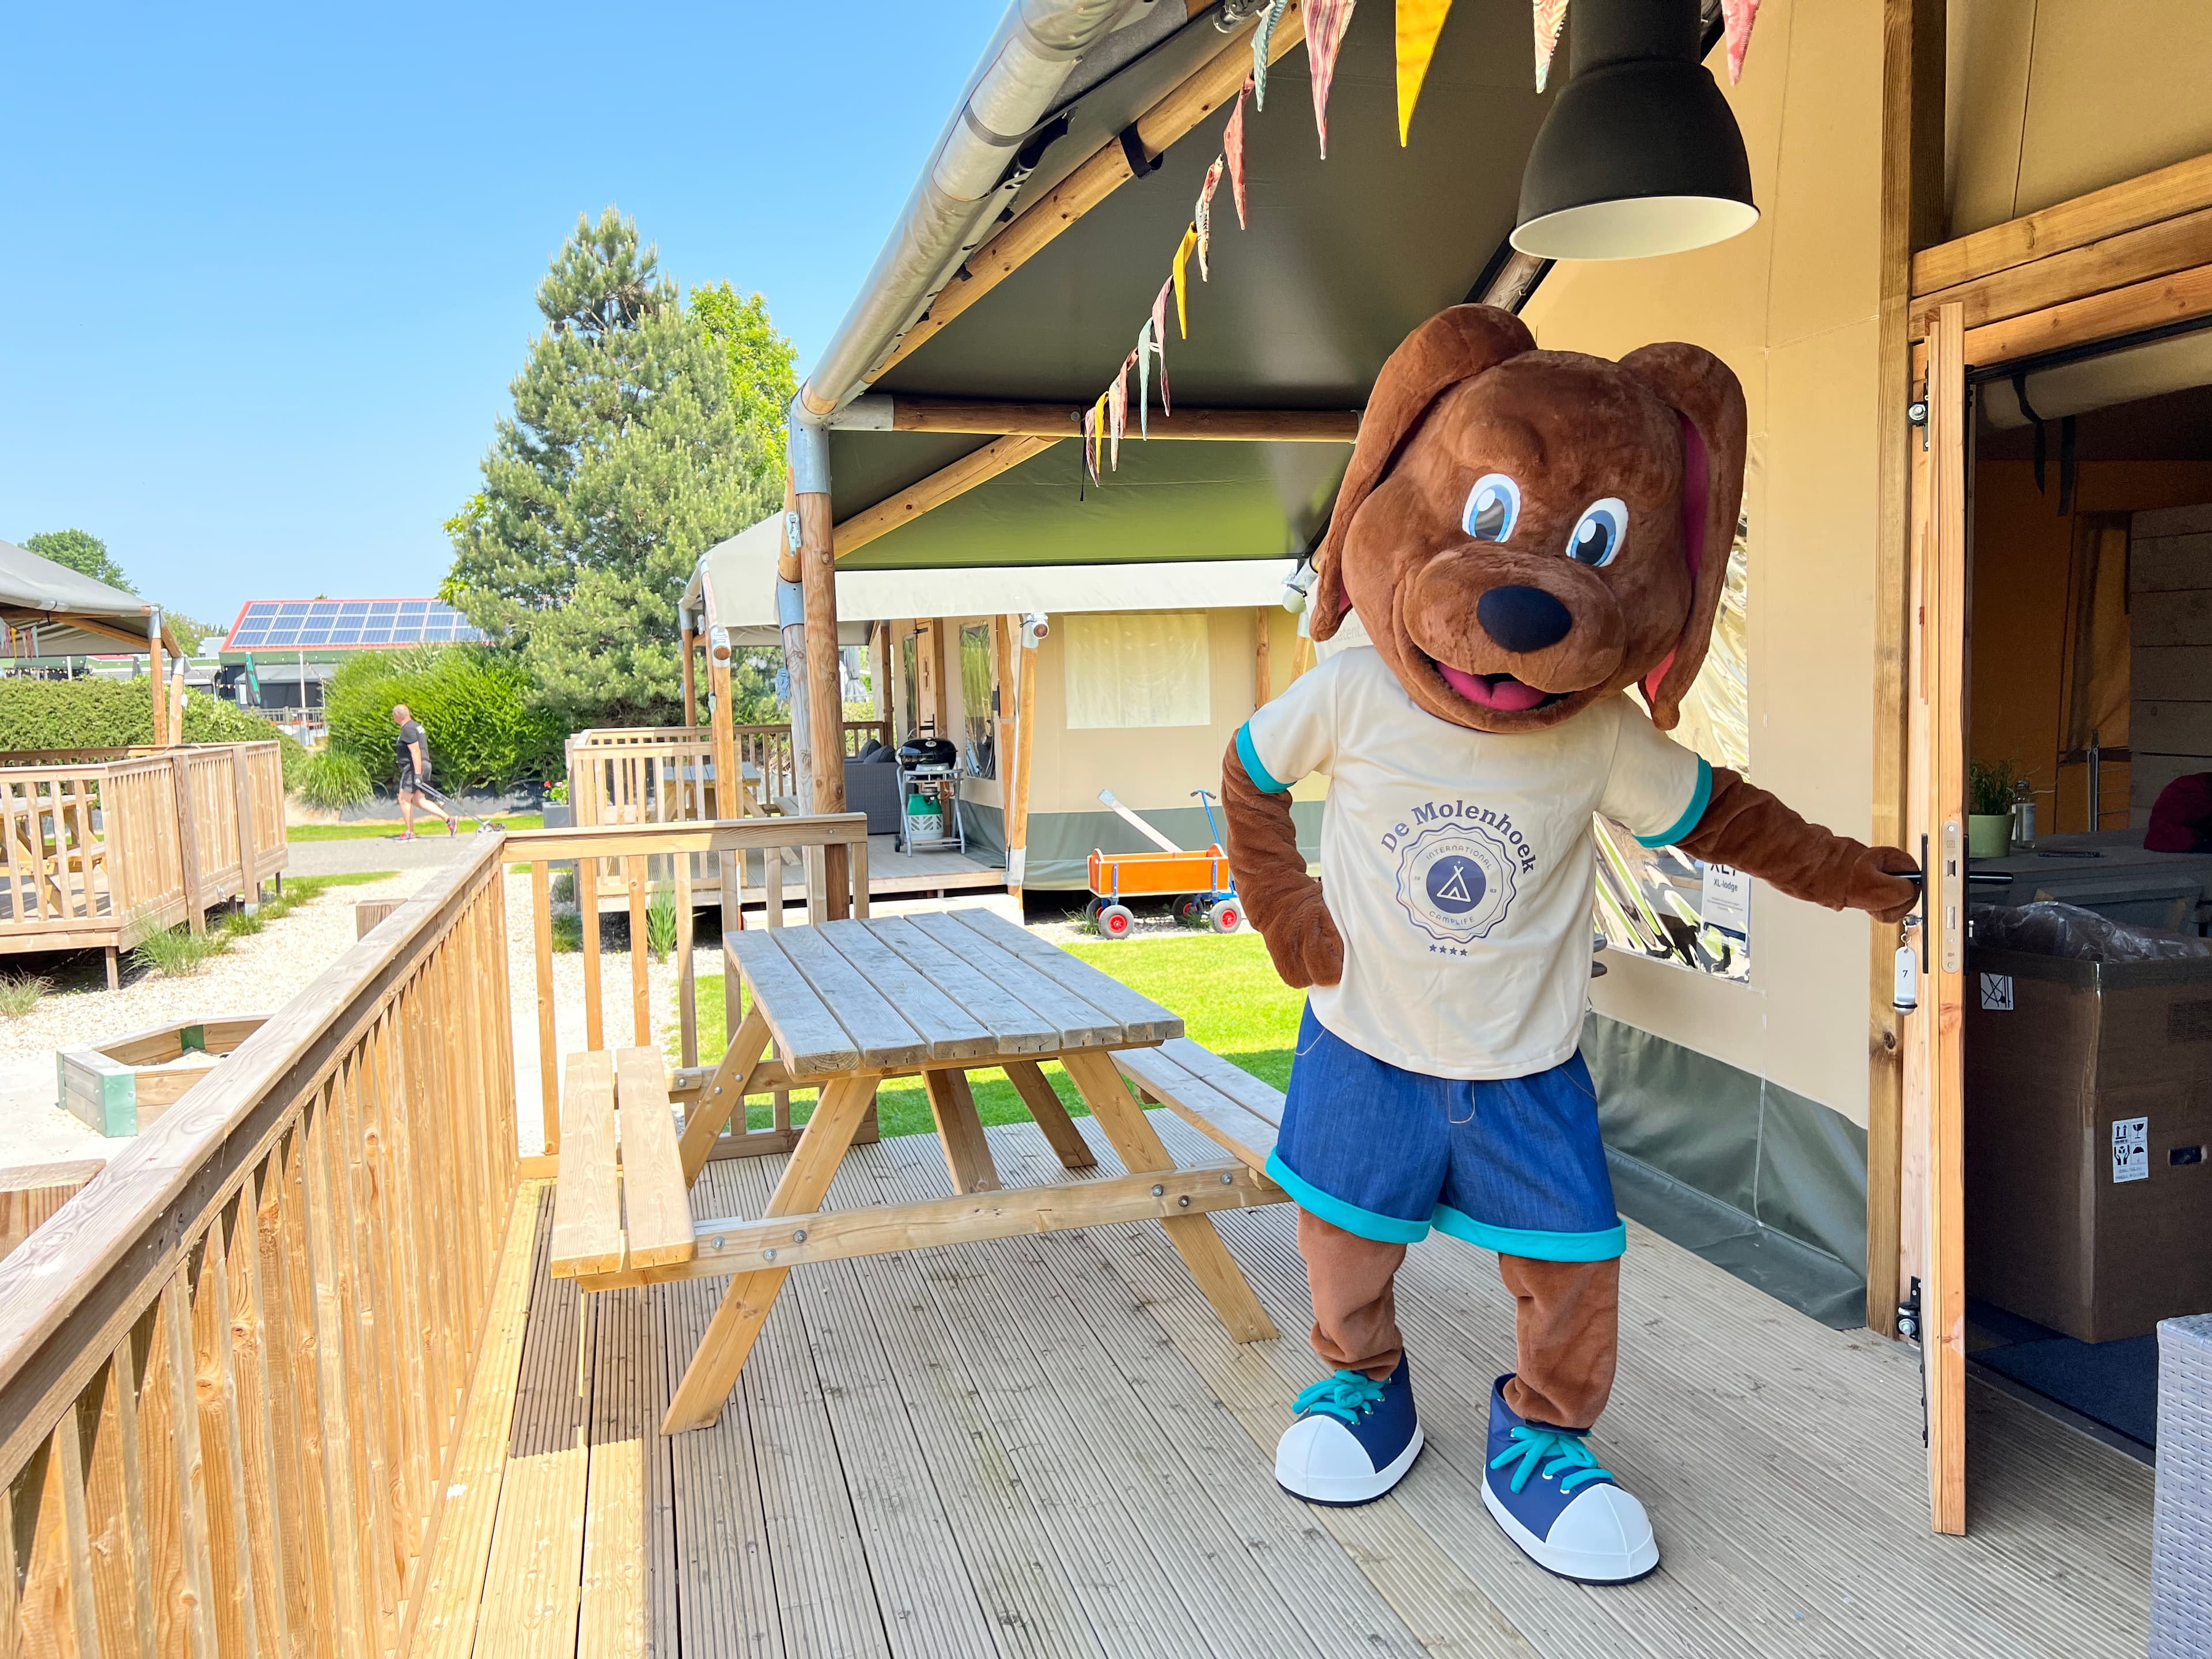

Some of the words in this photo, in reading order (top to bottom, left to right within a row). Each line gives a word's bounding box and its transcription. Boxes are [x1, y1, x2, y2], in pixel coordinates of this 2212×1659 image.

[1381, 823, 1409, 853] De
[1411, 800, 1536, 874] Molenhoek
[1425, 845, 1492, 870] INTERNATIONAL
[1714, 878, 1738, 892] XL-lodge
[1429, 911, 1475, 925] CAMPLIFE
[1903, 969, 1908, 978] 7
